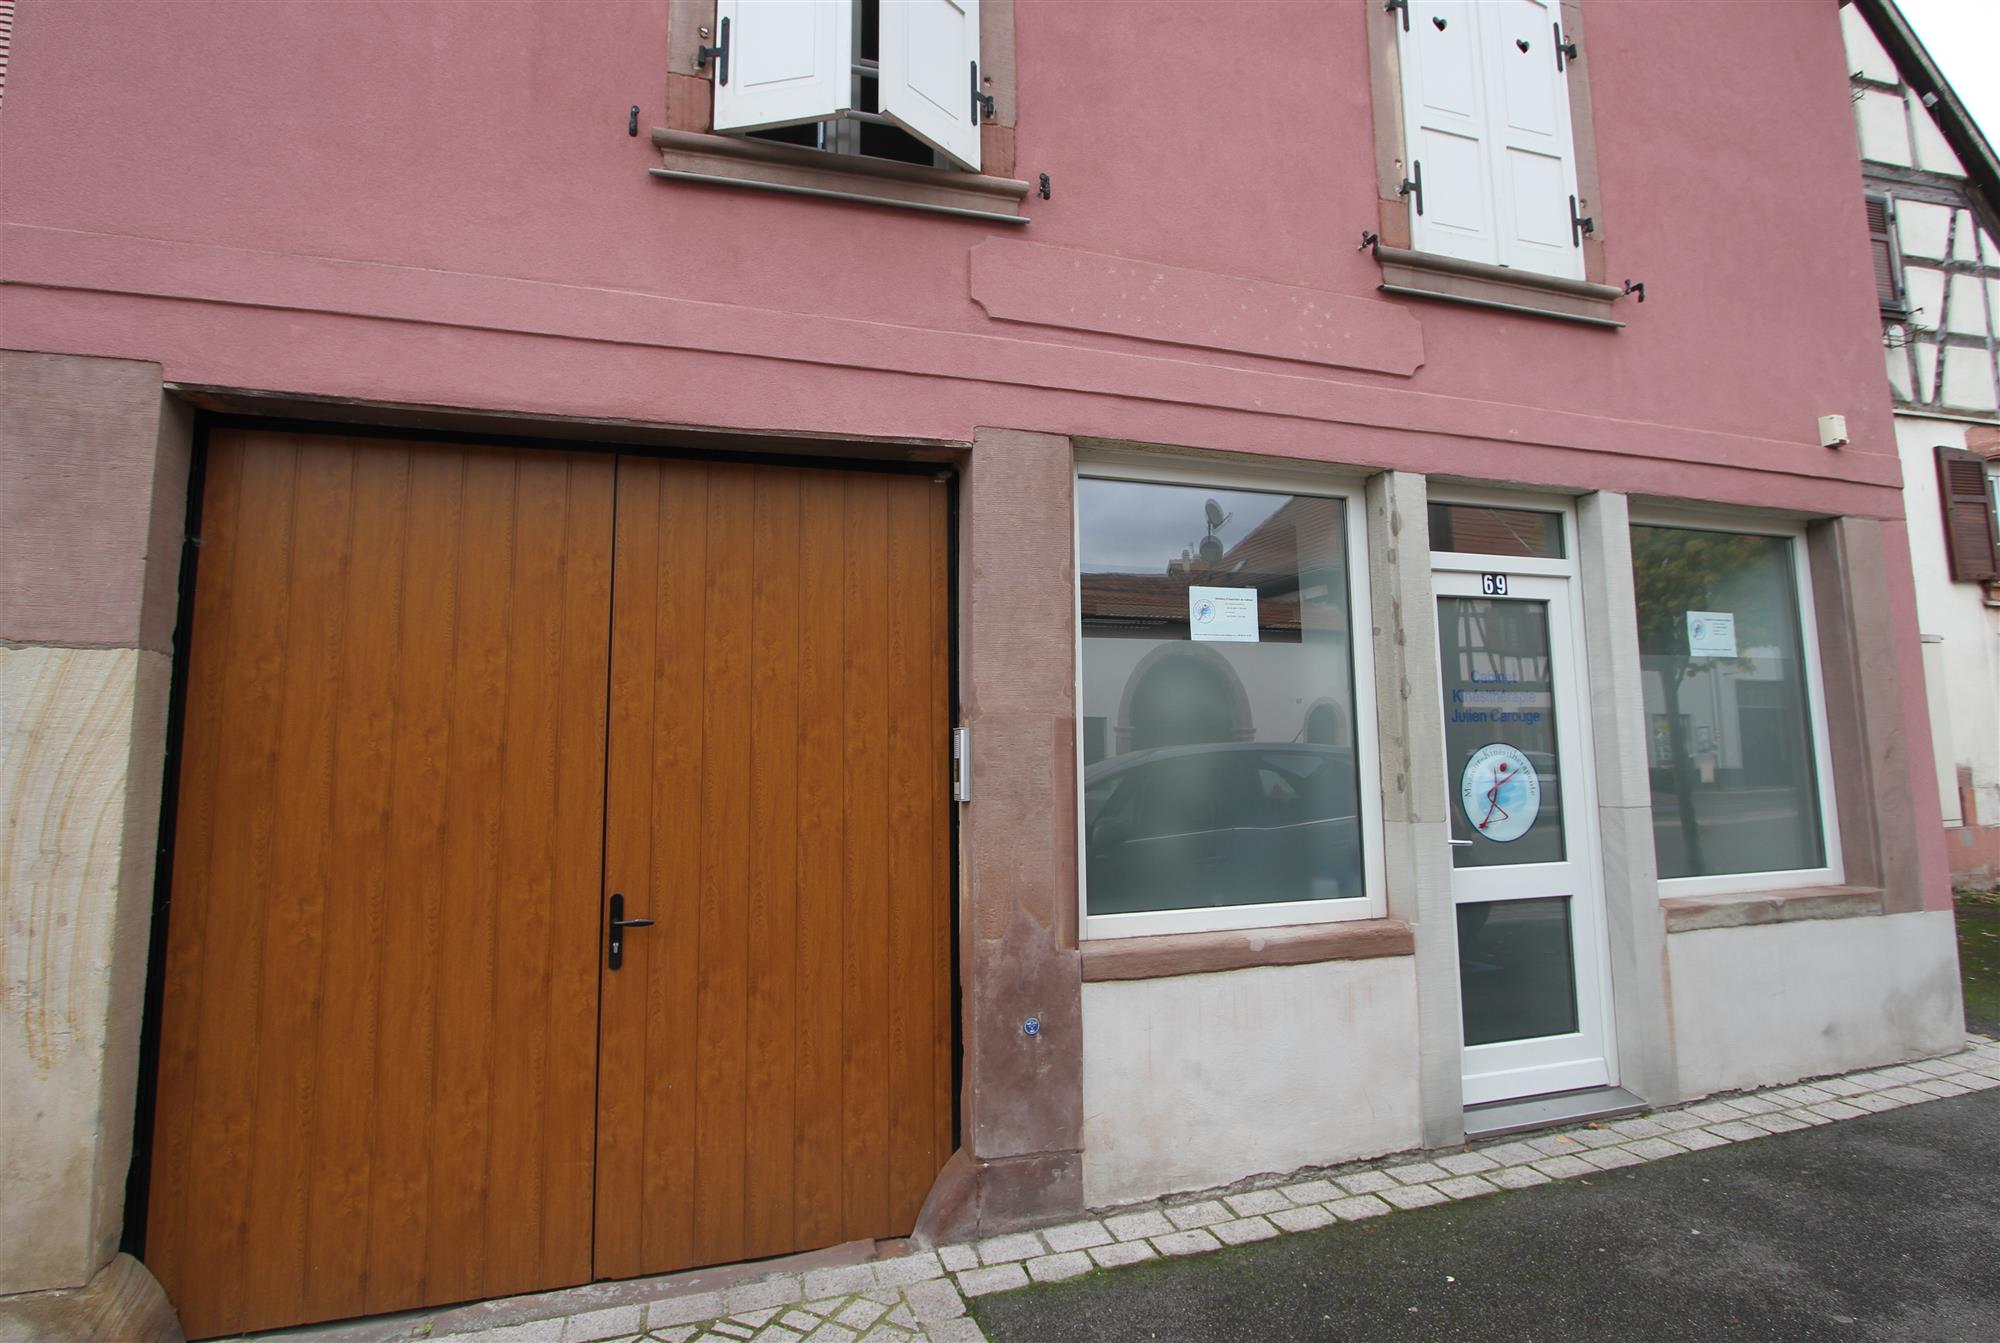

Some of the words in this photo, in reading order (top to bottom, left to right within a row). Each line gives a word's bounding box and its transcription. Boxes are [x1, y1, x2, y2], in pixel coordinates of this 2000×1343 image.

[1483, 575, 1507, 595] 69
[1451, 708, 1488, 723] Julien
[1489, 708, 1541, 725] Carouge
